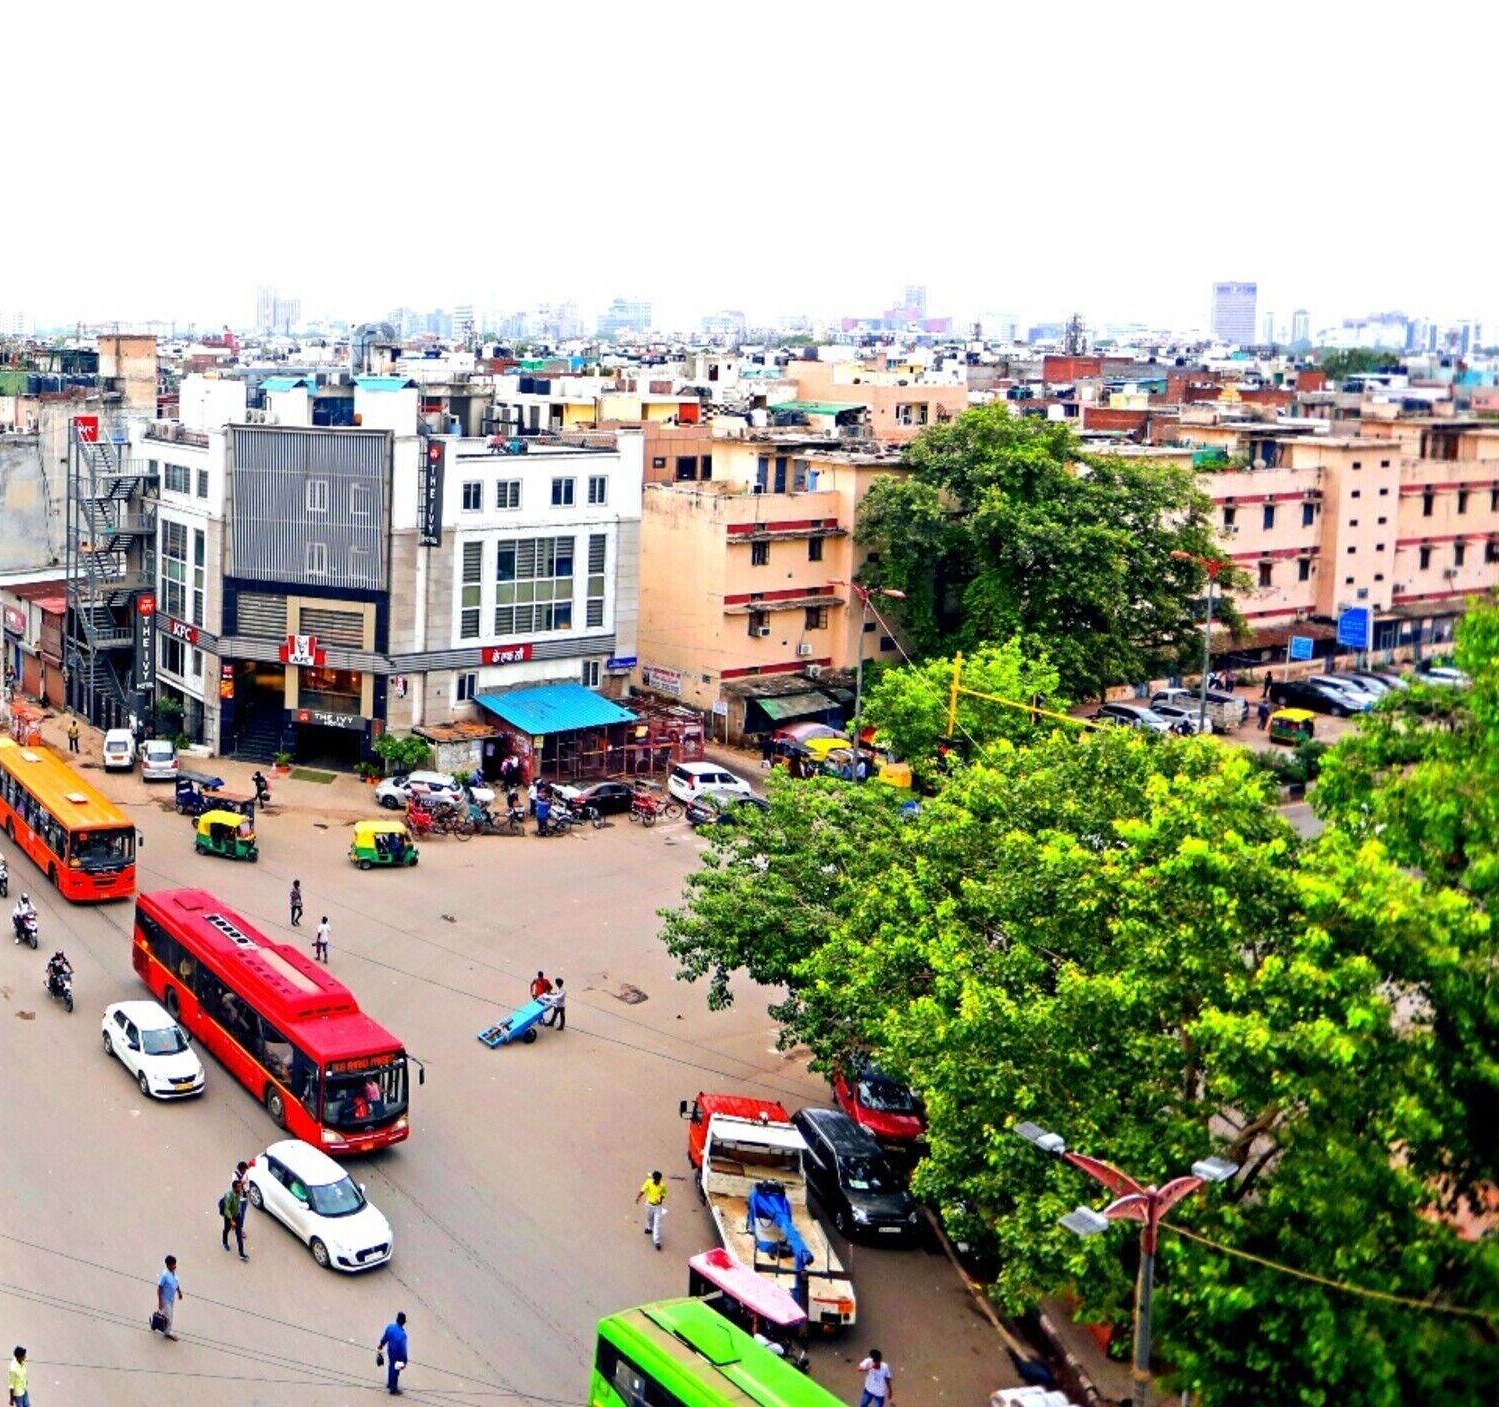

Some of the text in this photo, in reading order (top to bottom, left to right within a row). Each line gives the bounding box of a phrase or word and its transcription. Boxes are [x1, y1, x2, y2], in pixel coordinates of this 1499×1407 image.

[429, 464, 437, 499] THE
[172, 621, 192, 641] KFC
[142, 616, 151, 680] THE IVY
[292, 655, 310, 664] KFC
[314, 713, 333, 721] THE
[336, 716, 354, 724] IVY
